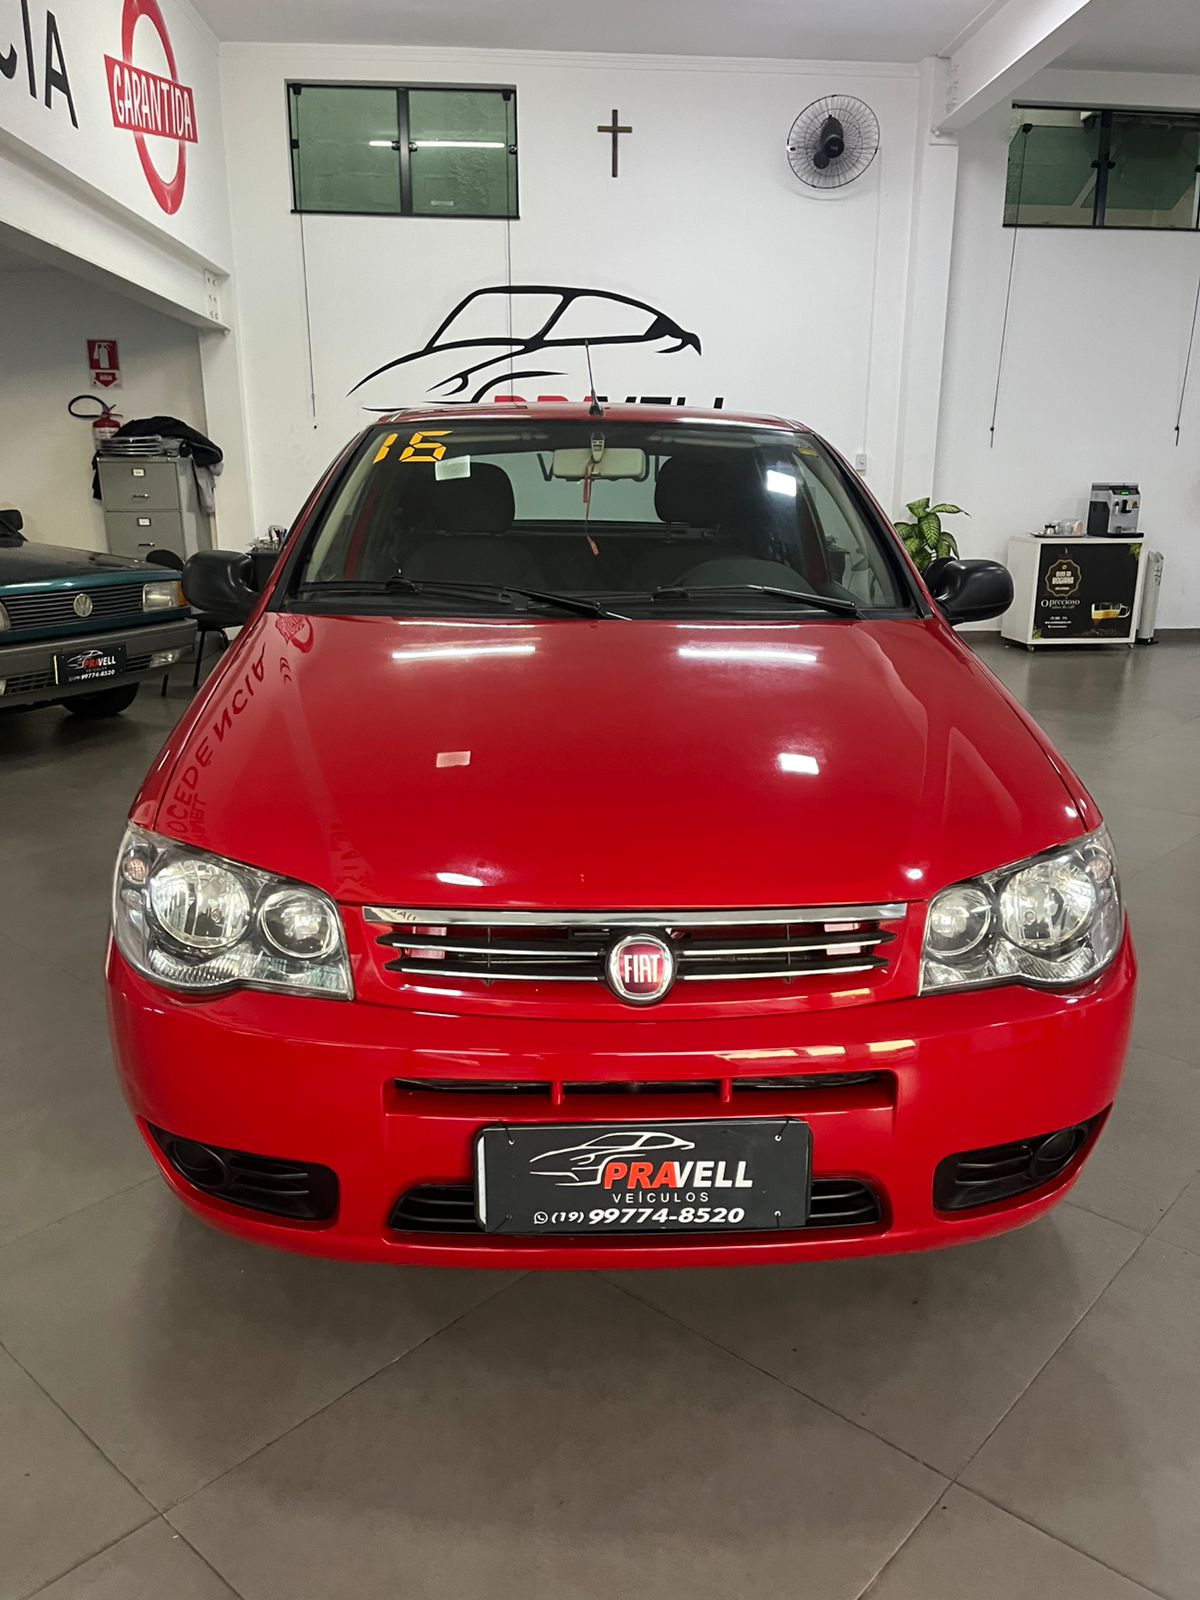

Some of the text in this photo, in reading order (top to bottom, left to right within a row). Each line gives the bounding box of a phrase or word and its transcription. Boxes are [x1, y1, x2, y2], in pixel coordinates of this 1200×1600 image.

[112, 64, 194, 139] GARANTIDA
[372, 430, 453, 465] 16
[83, 655, 116, 670] PRAVELL
[623, 954, 661, 984] FIAT
[604, 1161, 753, 1189] PRAVELL
[551, 1207, 745, 1225] (19) 99774-8520
